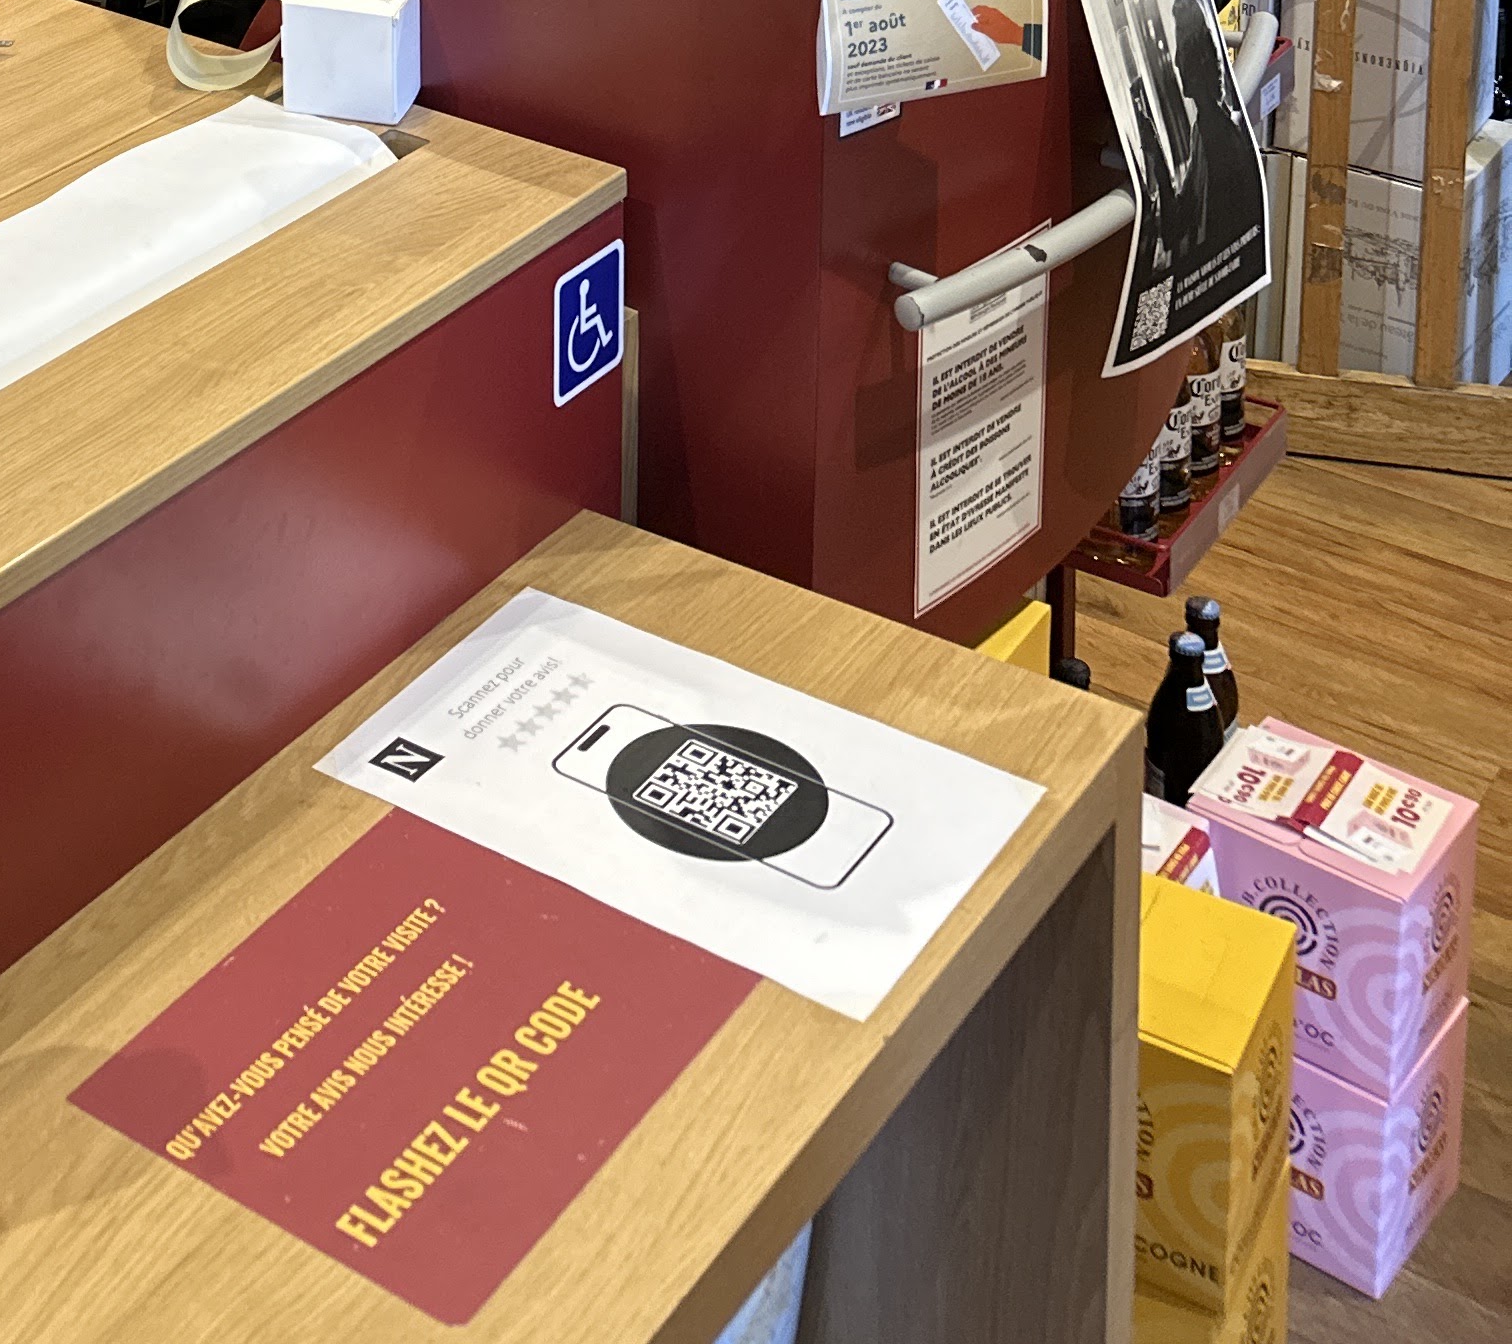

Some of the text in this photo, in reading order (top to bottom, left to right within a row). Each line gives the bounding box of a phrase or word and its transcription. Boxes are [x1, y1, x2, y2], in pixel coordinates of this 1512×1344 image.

[847, 37, 889, 59] 2023
[869, 12, 907, 33] août
[447, 655, 526, 722] Scannez pour
[462, 707, 505, 743] donner
[500, 681, 532, 711] votre
[391, 743, 435, 776] N
[165, 1047, 288, 1162] QU'AVEZ-VOUS
[277, 1004, 332, 1061] PENSÉ
[318, 987, 353, 1020] DE
[339, 946, 397, 999] VOTRE
[387, 908, 439, 956] VISITE
[258, 1095, 322, 1159] VOTRE
[311, 1068, 358, 1112] AVIS
[343, 1028, 398, 1076] NOUS
[383, 959, 466, 1041] INTÉRESSE
[336, 979, 602, 1248] FLASHEZ LE QR CODE
